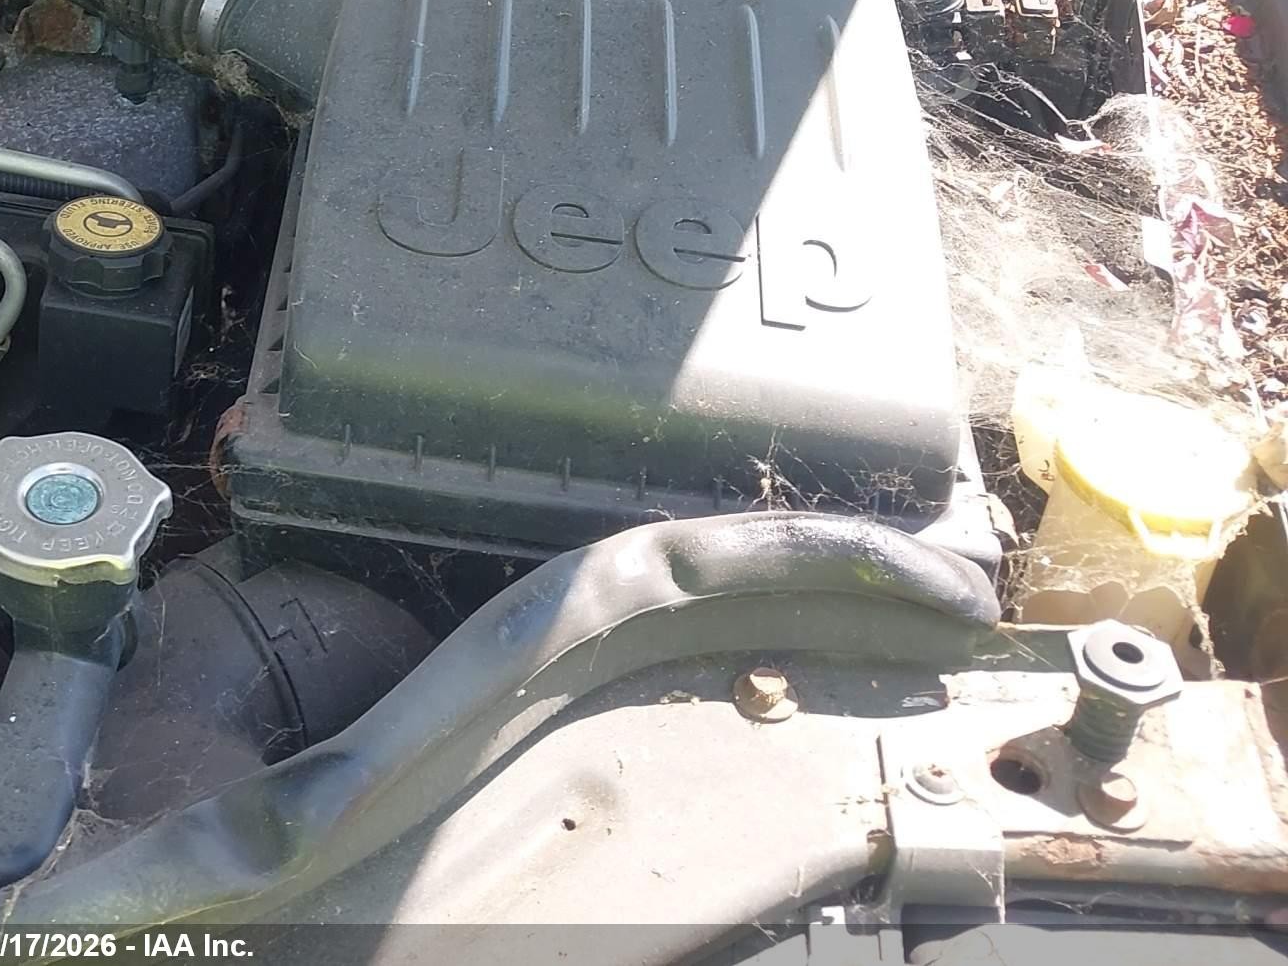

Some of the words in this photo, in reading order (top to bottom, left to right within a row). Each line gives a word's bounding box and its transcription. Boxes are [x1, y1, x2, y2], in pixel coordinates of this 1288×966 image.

[60, 202, 87, 220] FLUID
[90, 197, 145, 213] STEERING
[62, 227, 113, 251] APPROVED
[119, 239, 139, 251] USE
[376, 146, 874, 332] Jeep
[41, 530, 106, 552] KEEP
